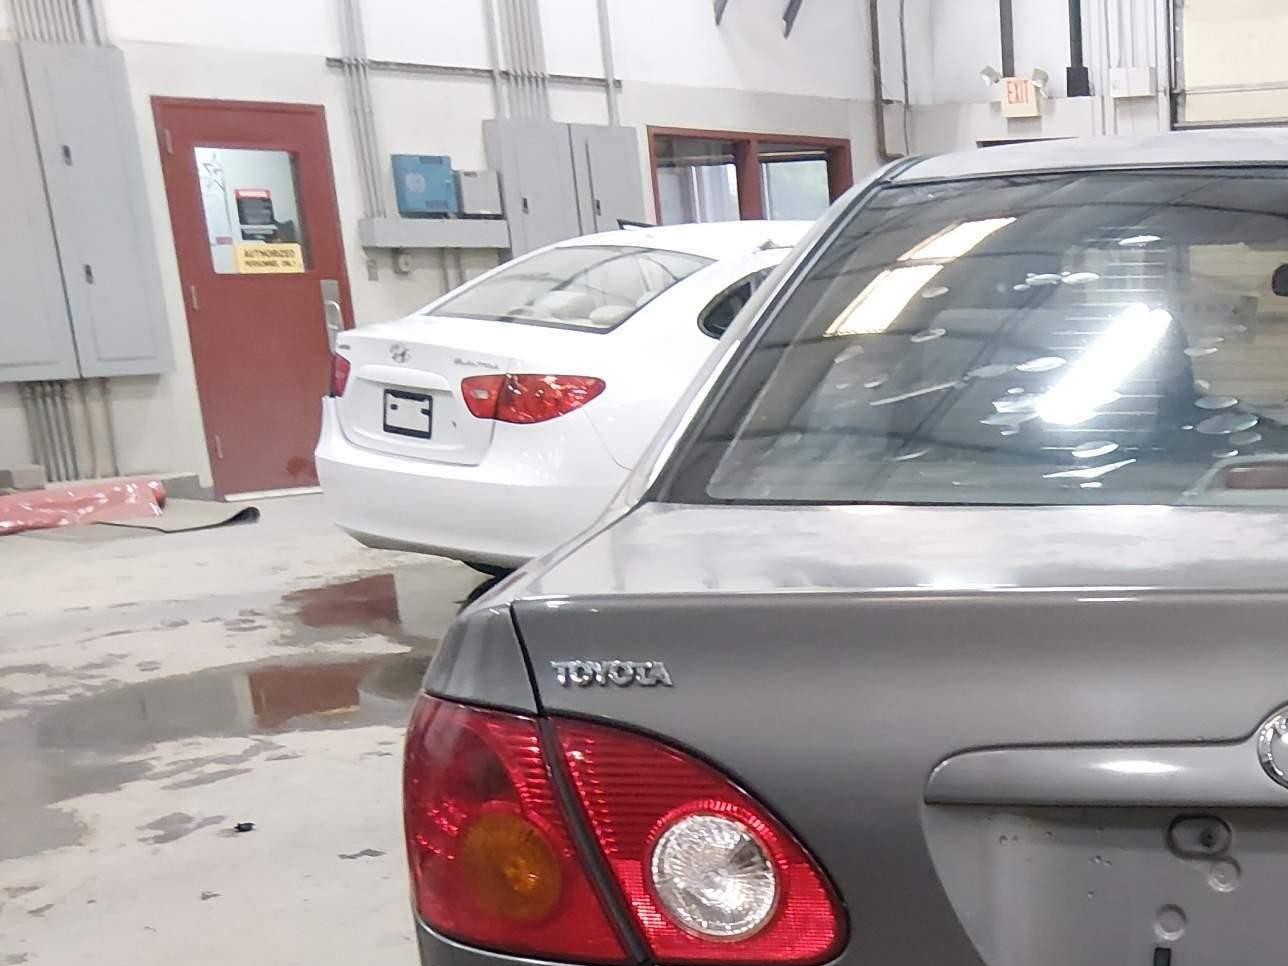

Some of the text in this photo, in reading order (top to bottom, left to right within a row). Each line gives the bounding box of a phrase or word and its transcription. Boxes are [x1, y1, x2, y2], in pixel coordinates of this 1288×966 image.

[1007, 79, 1029, 105] EXIT
[244, 249, 297, 258] AUTHORIZED
[551, 659, 674, 687] TOYOTA
